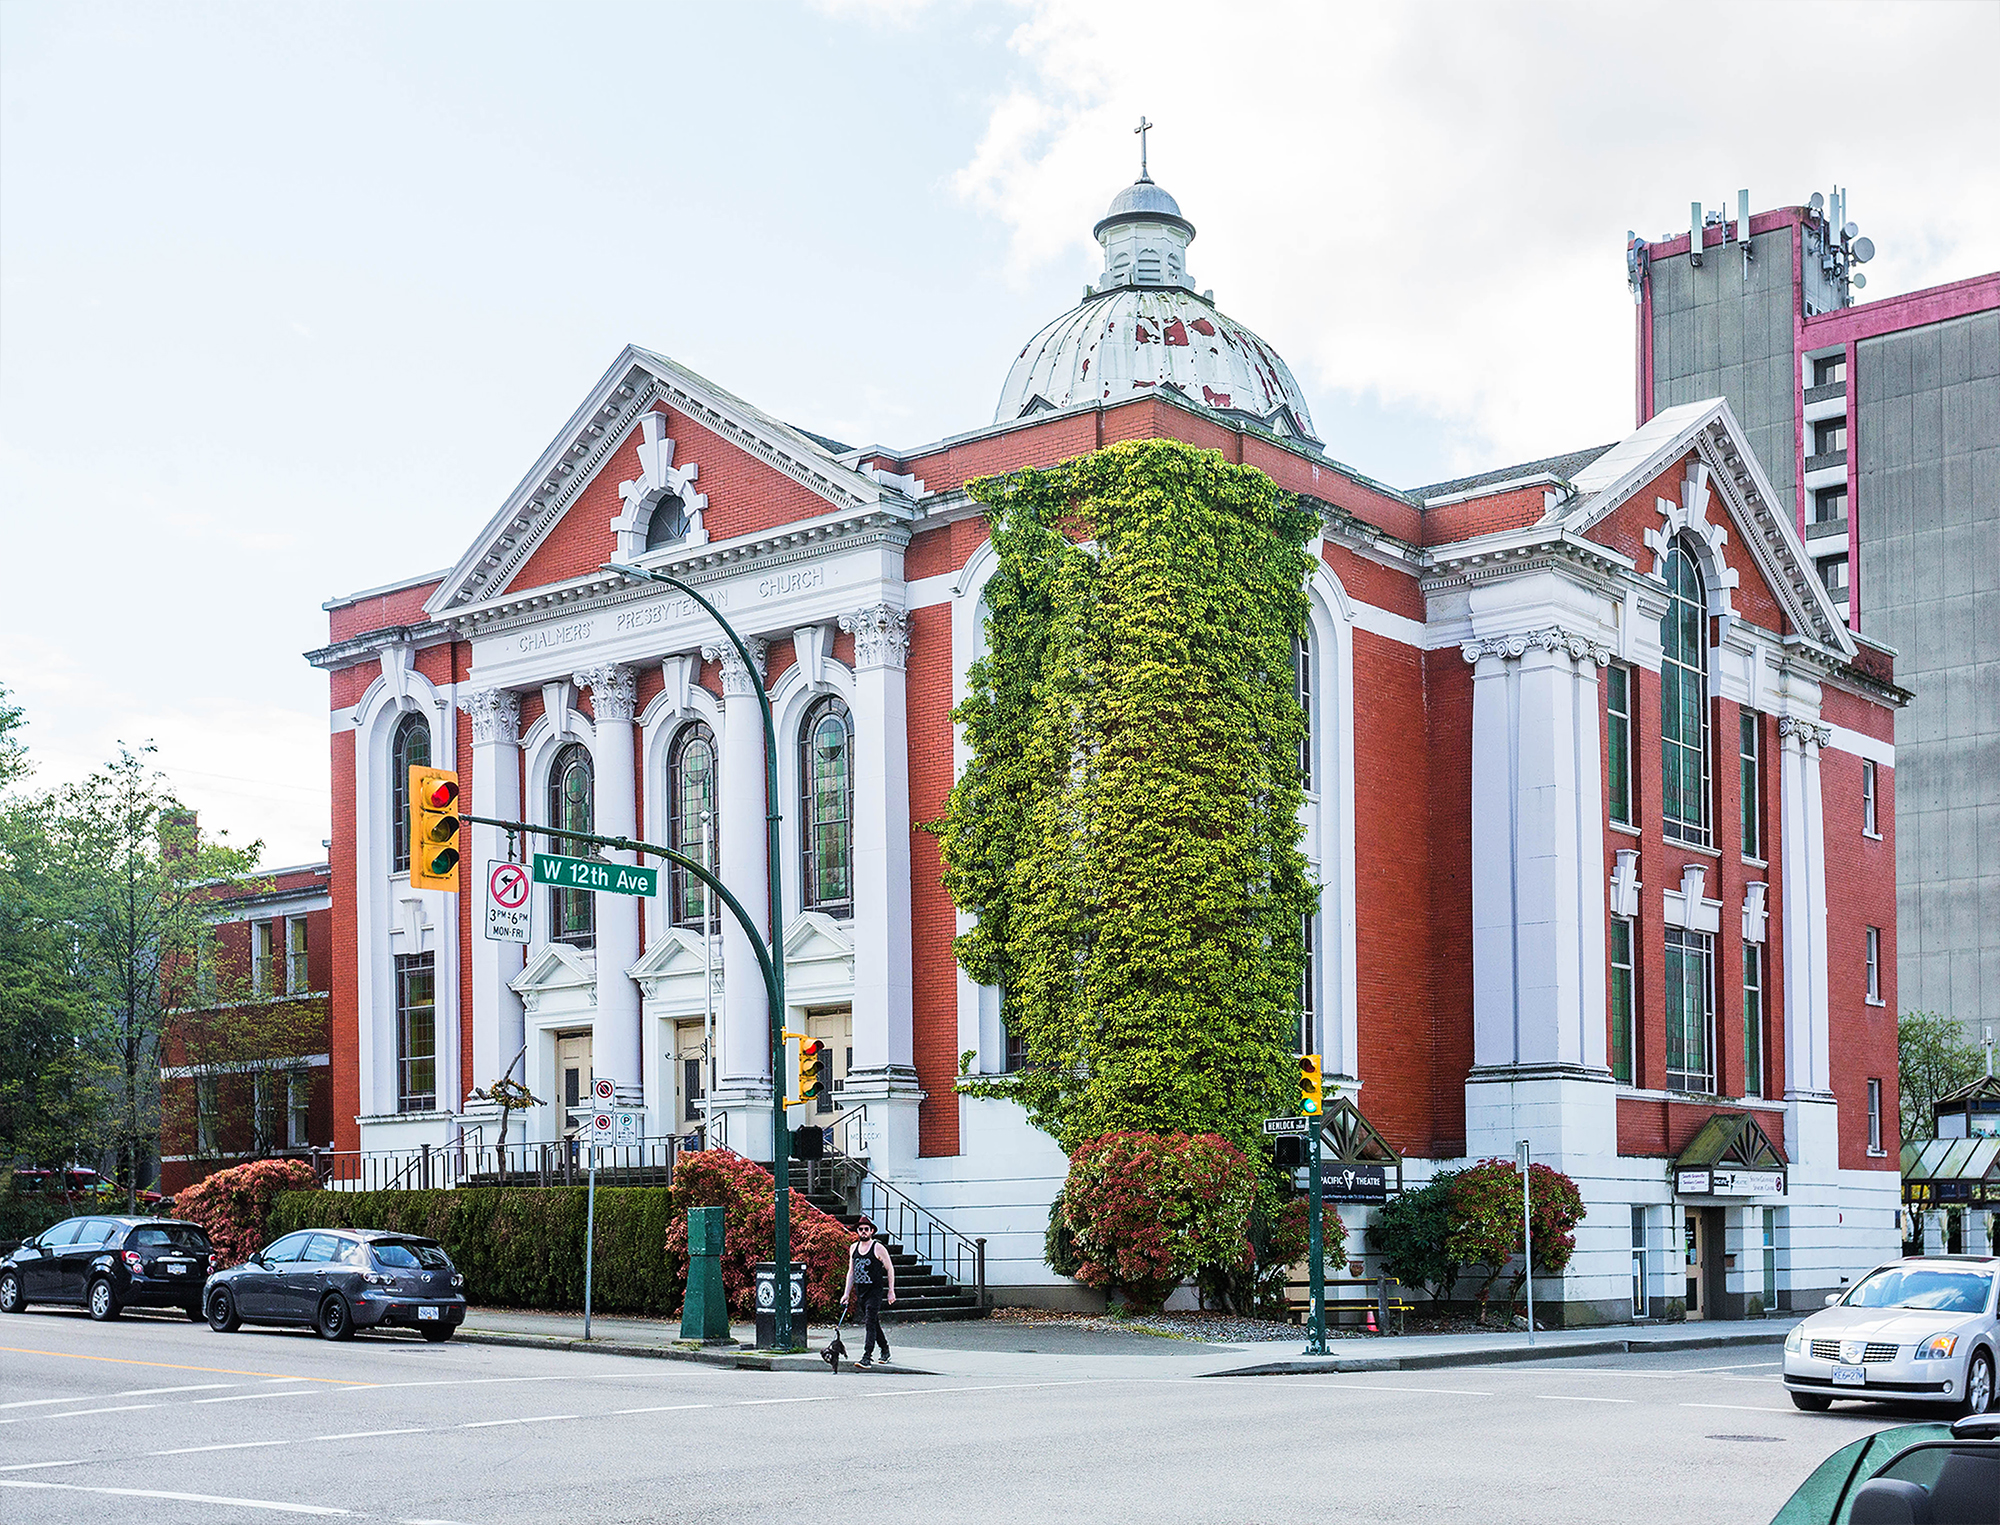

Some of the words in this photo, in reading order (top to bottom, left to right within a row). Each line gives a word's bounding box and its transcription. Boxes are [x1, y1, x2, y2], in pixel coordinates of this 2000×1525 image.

[616, 589, 728, 632] PRESBYTERAN
[758, 566, 824, 599] CHURCH
[543, 859, 562, 881] W
[570, 863, 609, 887] 12th
[616, 870, 649, 892] Ave
[1267, 1120, 1295, 1131] HEMLOCK
[1355, 1176, 1381, 1186] THEATRE
